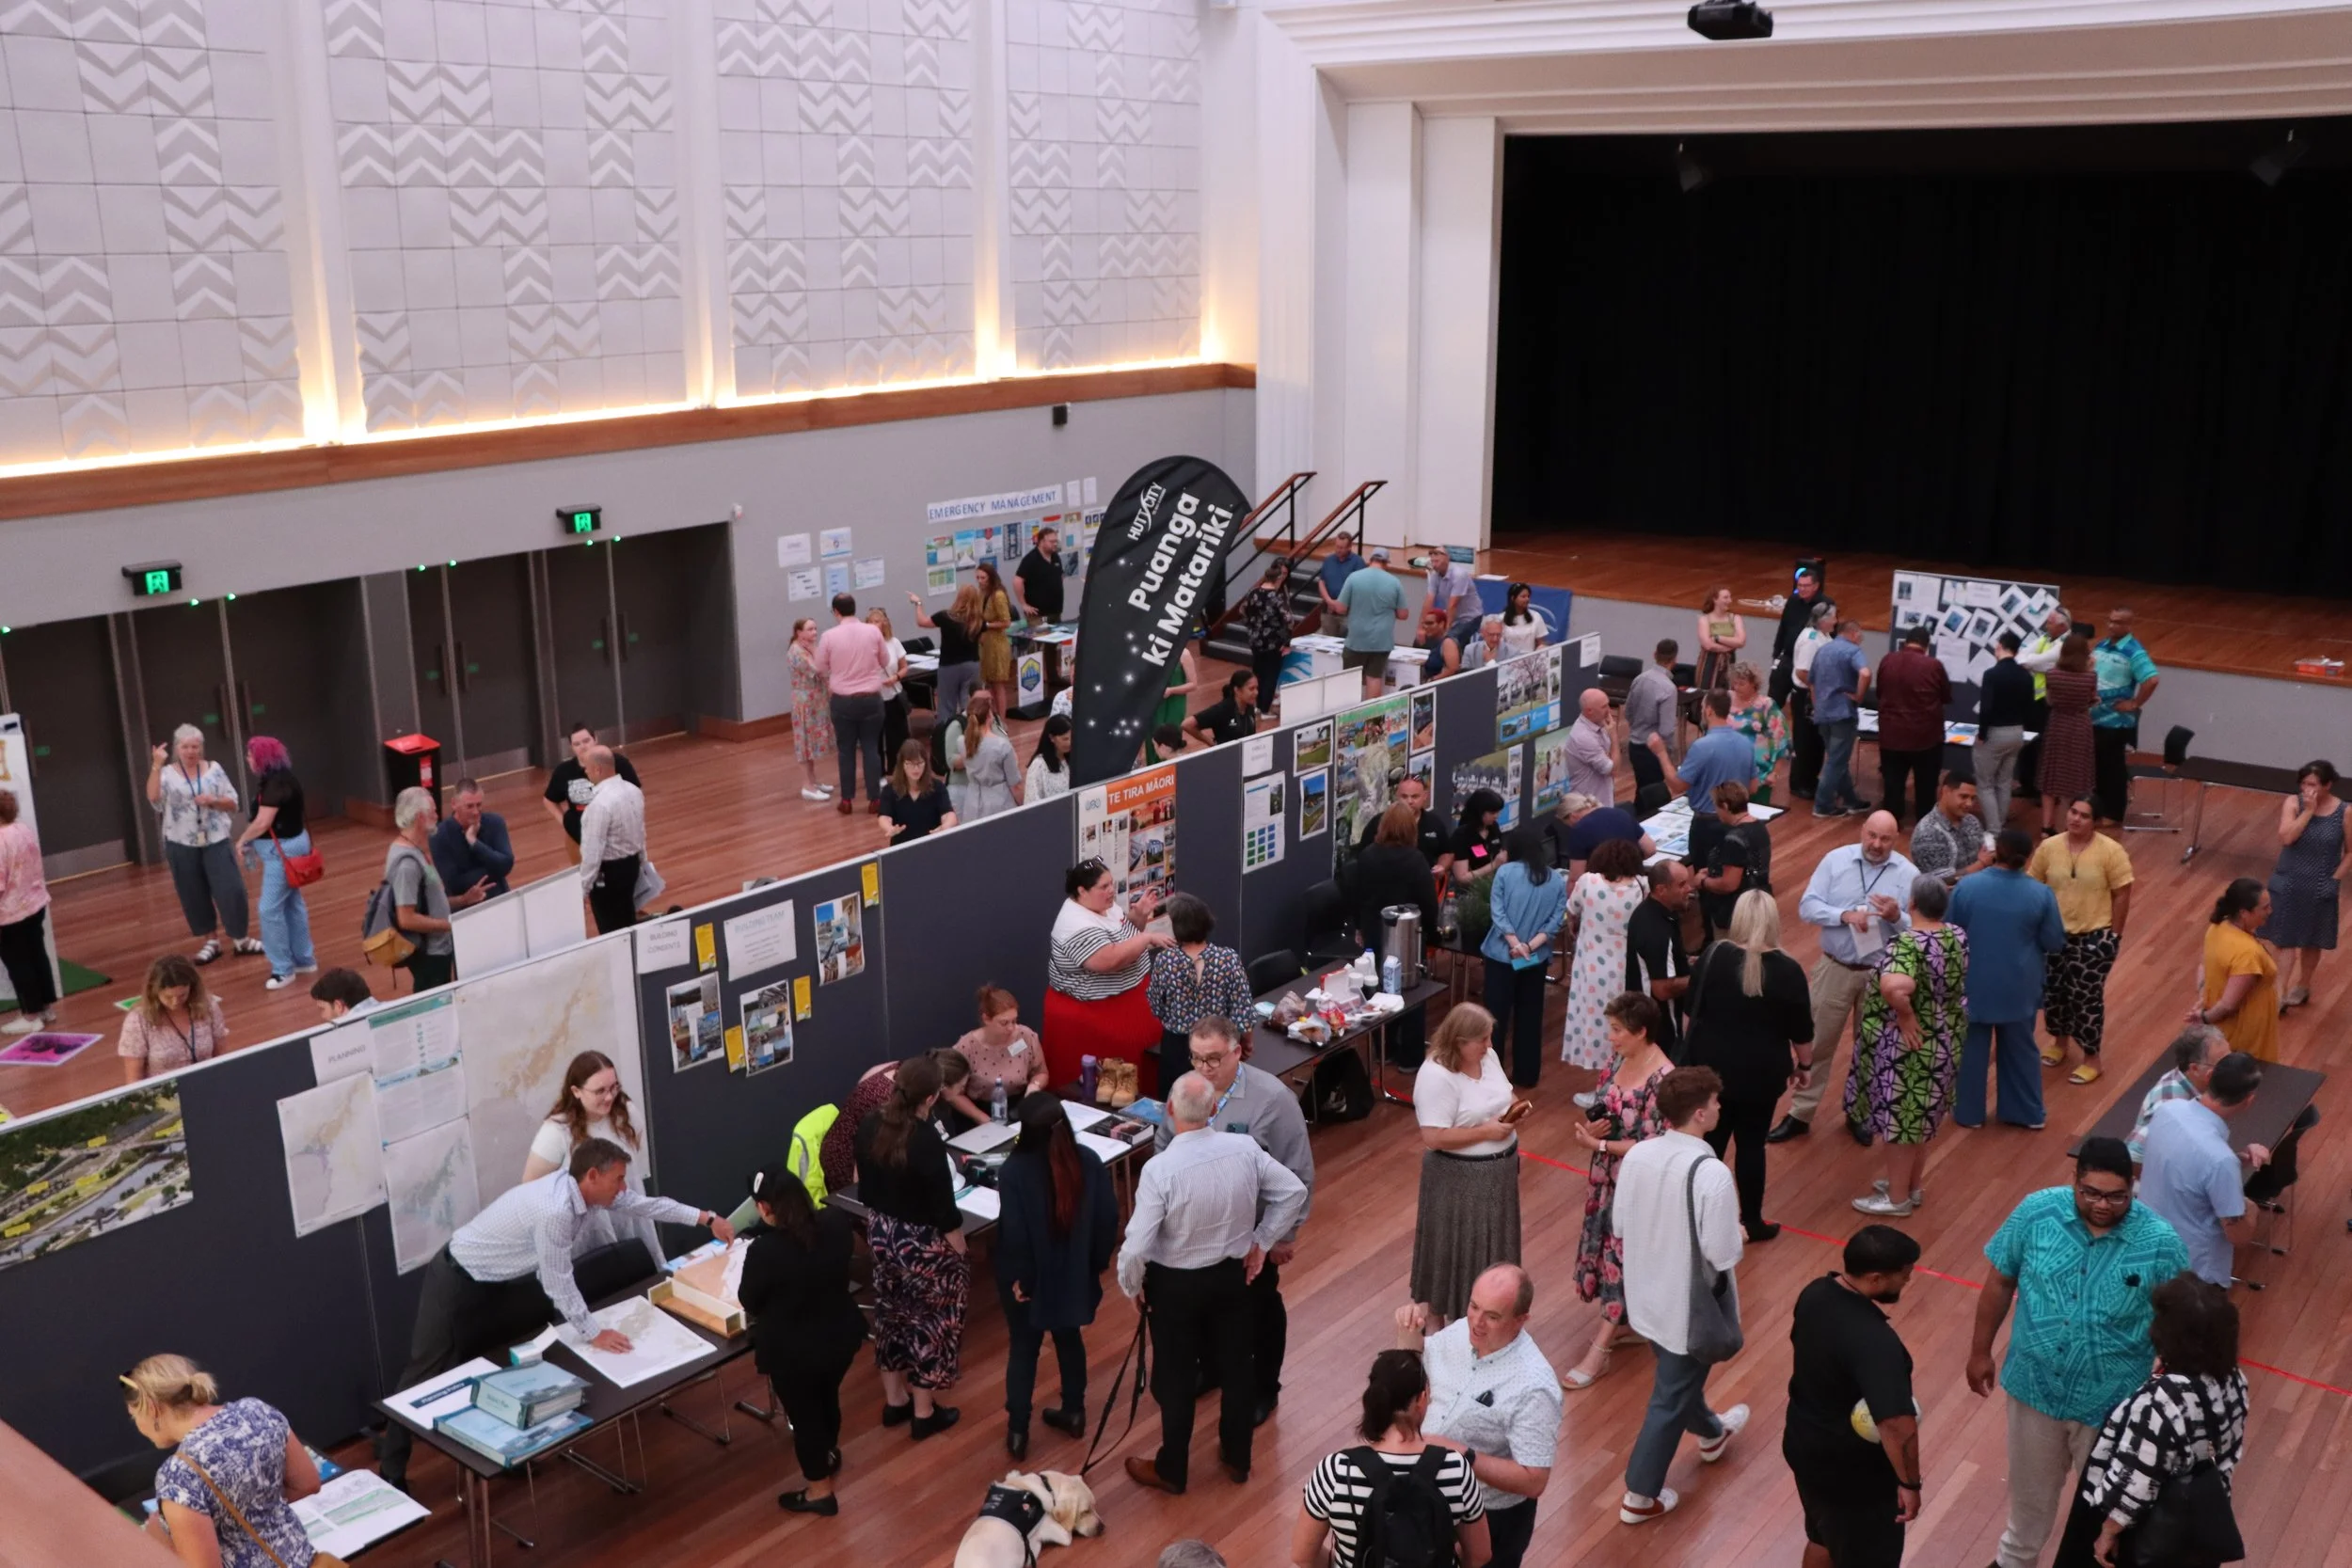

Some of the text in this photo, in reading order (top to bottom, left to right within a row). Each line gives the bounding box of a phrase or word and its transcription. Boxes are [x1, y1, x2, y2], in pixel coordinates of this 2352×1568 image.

[929, 490, 1057, 520] EMERGENCY MANAGEMENT
[1128, 509, 1147, 541] HUTT
[1128, 493, 1200, 611] Puanga
[1141, 504, 1233, 667] ki Matariki
[1108, 774, 1175, 806] TE TIRA MĀORI
[766, 910, 786, 923] TEAM
[649, 929, 678, 942] BUILDING
[327, 1044, 366, 1064] PLANNING
